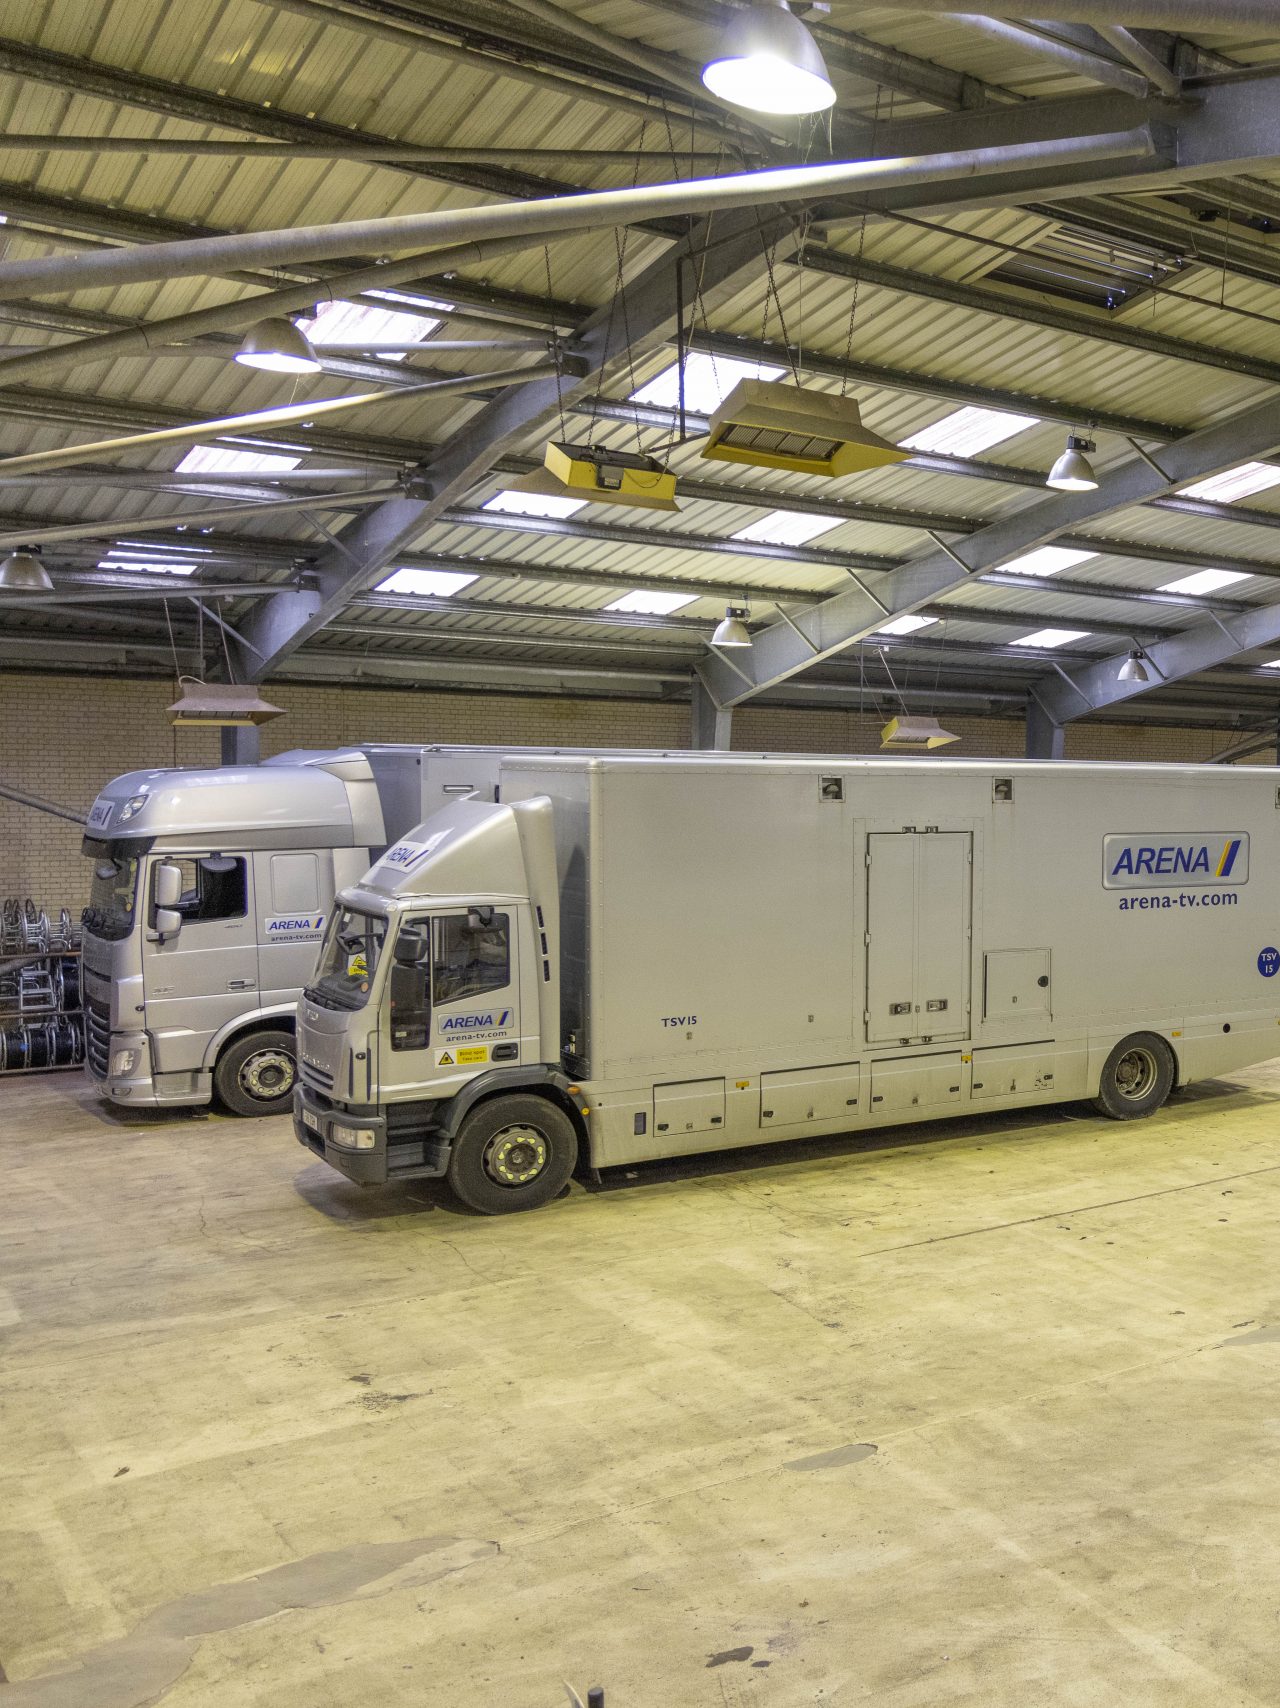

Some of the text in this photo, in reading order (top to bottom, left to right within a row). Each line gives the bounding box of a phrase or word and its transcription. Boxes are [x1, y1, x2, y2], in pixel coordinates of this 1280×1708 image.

[1112, 846, 1210, 876] ARENA
[1119, 892, 1238, 910] arena-tv.com
[268, 919, 311, 931] ARENA
[271, 933, 322, 942] arena-tv.com
[1260, 952, 1278, 962] TSV
[1265, 964, 1273, 974] 15
[442, 1014, 493, 1030] ARENA
[660, 1015, 697, 1028] TSV15
[446, 1031, 508, 1042] arena-tv.com
